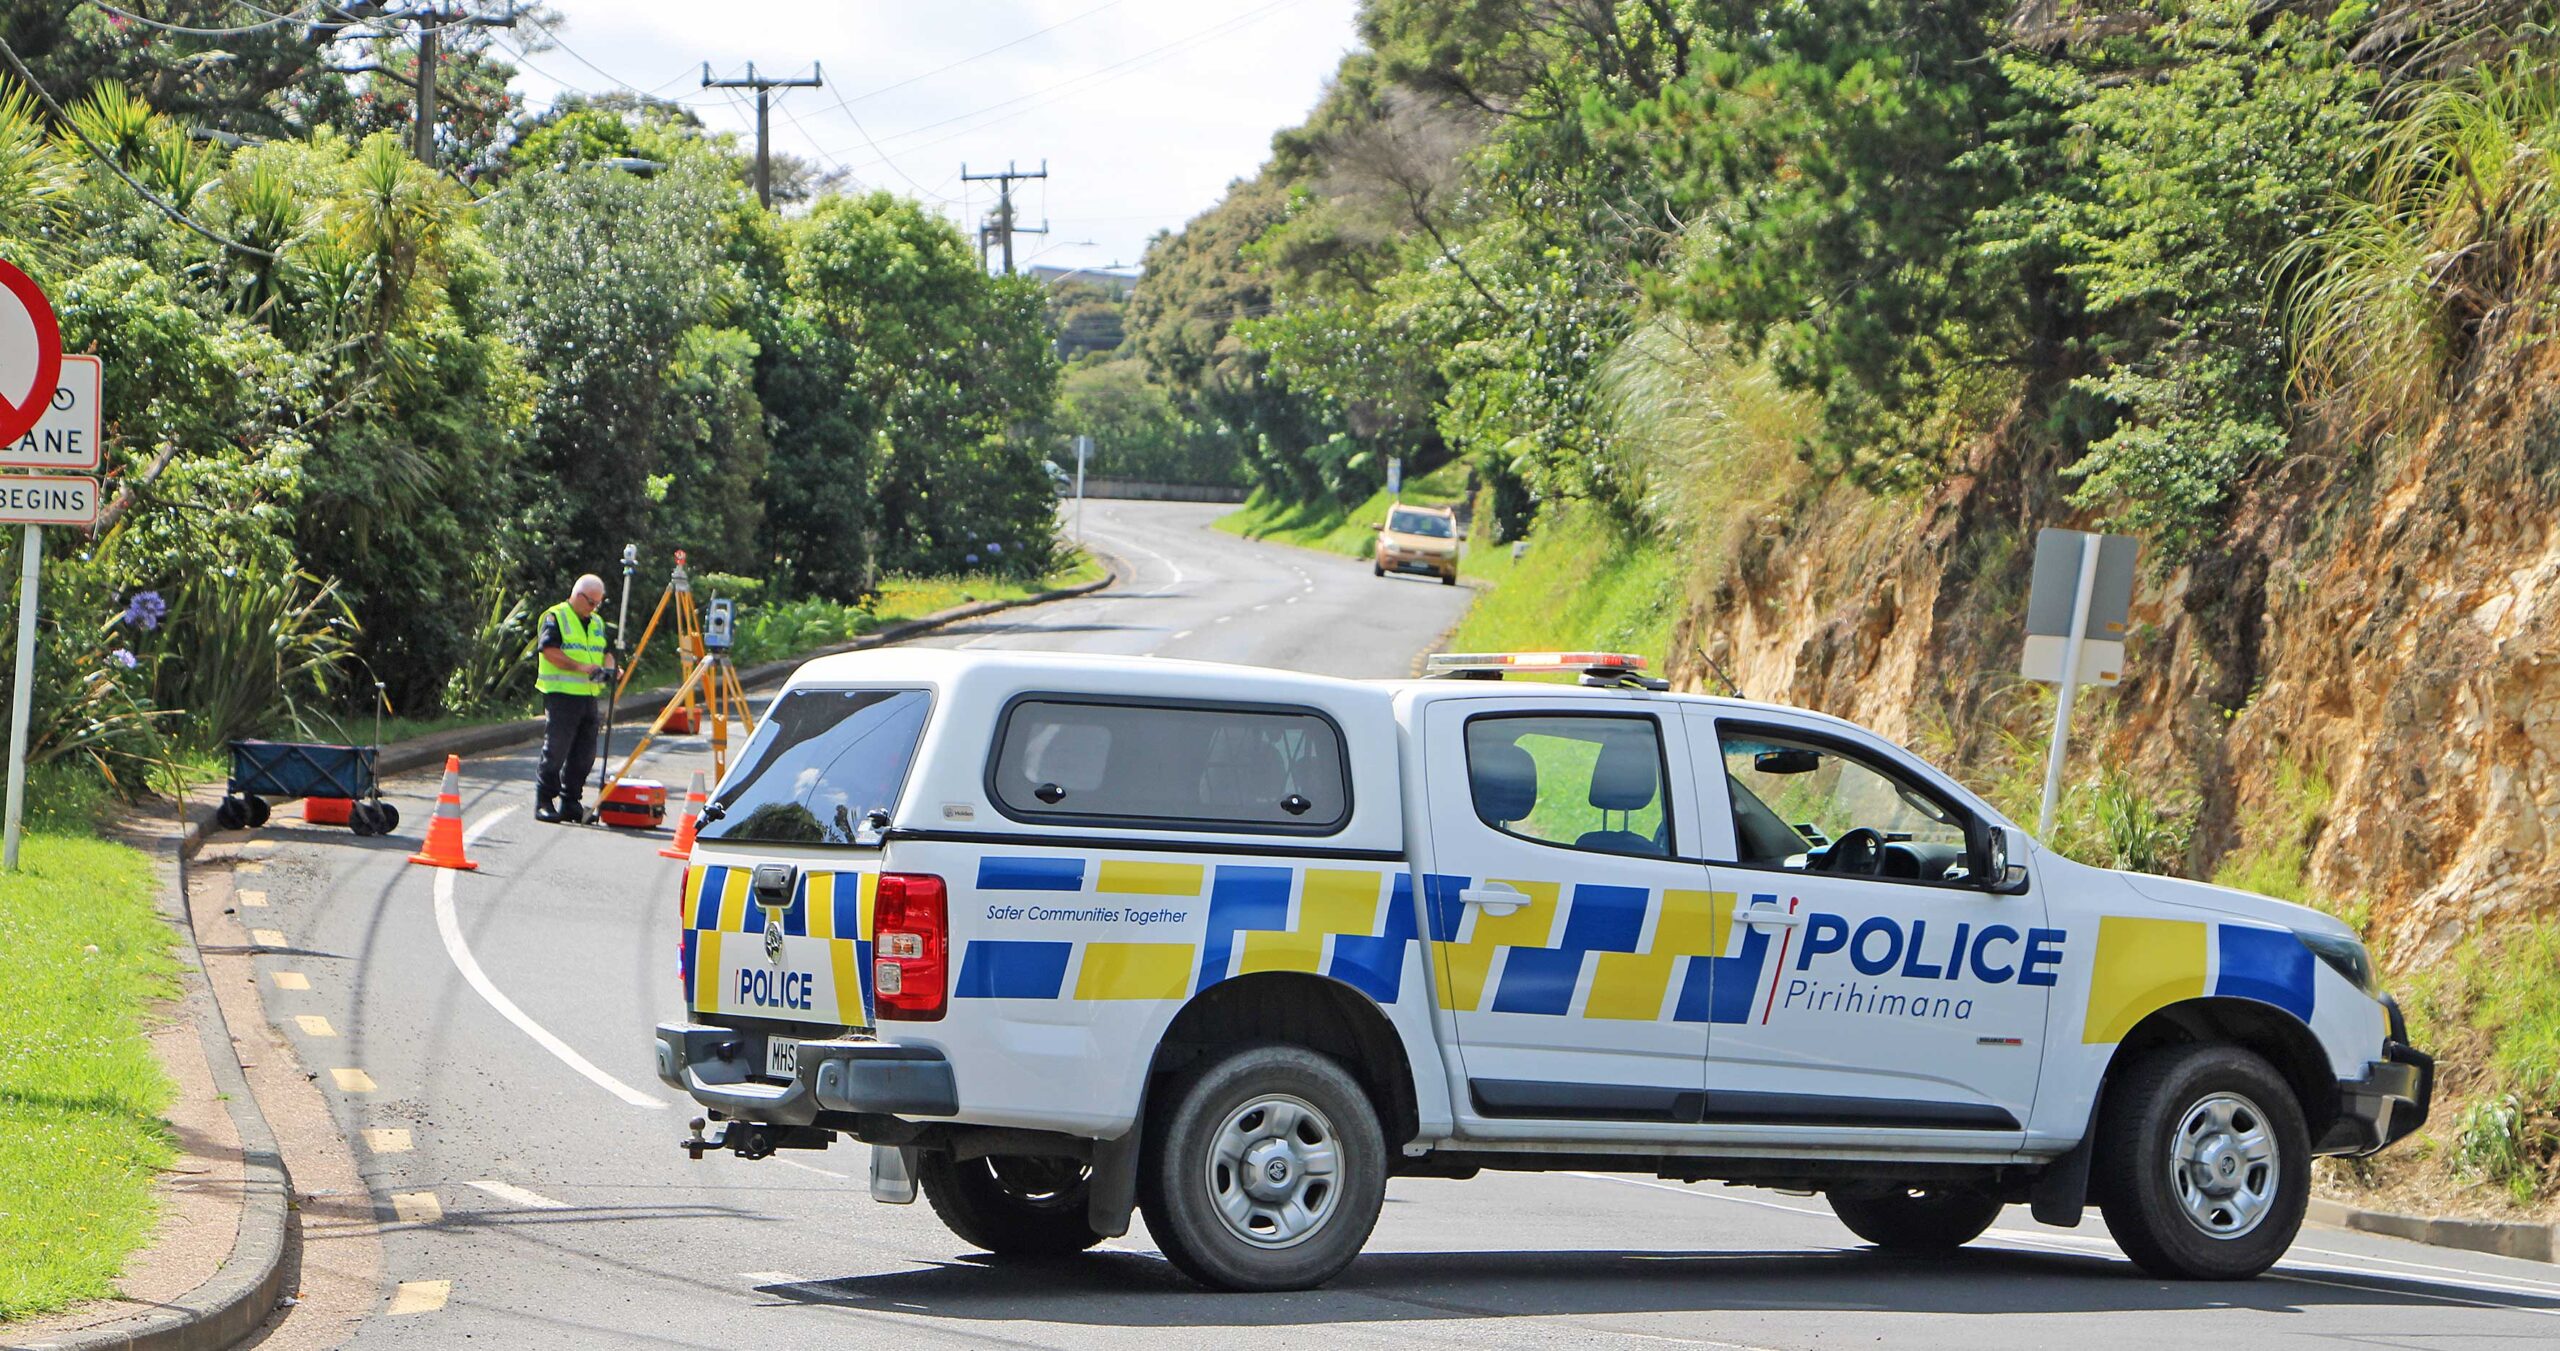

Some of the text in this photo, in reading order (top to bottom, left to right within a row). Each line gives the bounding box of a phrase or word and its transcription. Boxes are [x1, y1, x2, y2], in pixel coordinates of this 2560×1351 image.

[0, 429, 82, 454] ANE
[986, 905, 1188, 926] Safer Communities Together
[1796, 913, 2067, 987] POLICE
[740, 968, 813, 1010] POLICE
[1784, 979, 1973, 1020] Pirihimana
[772, 1042, 795, 1072] MHS
